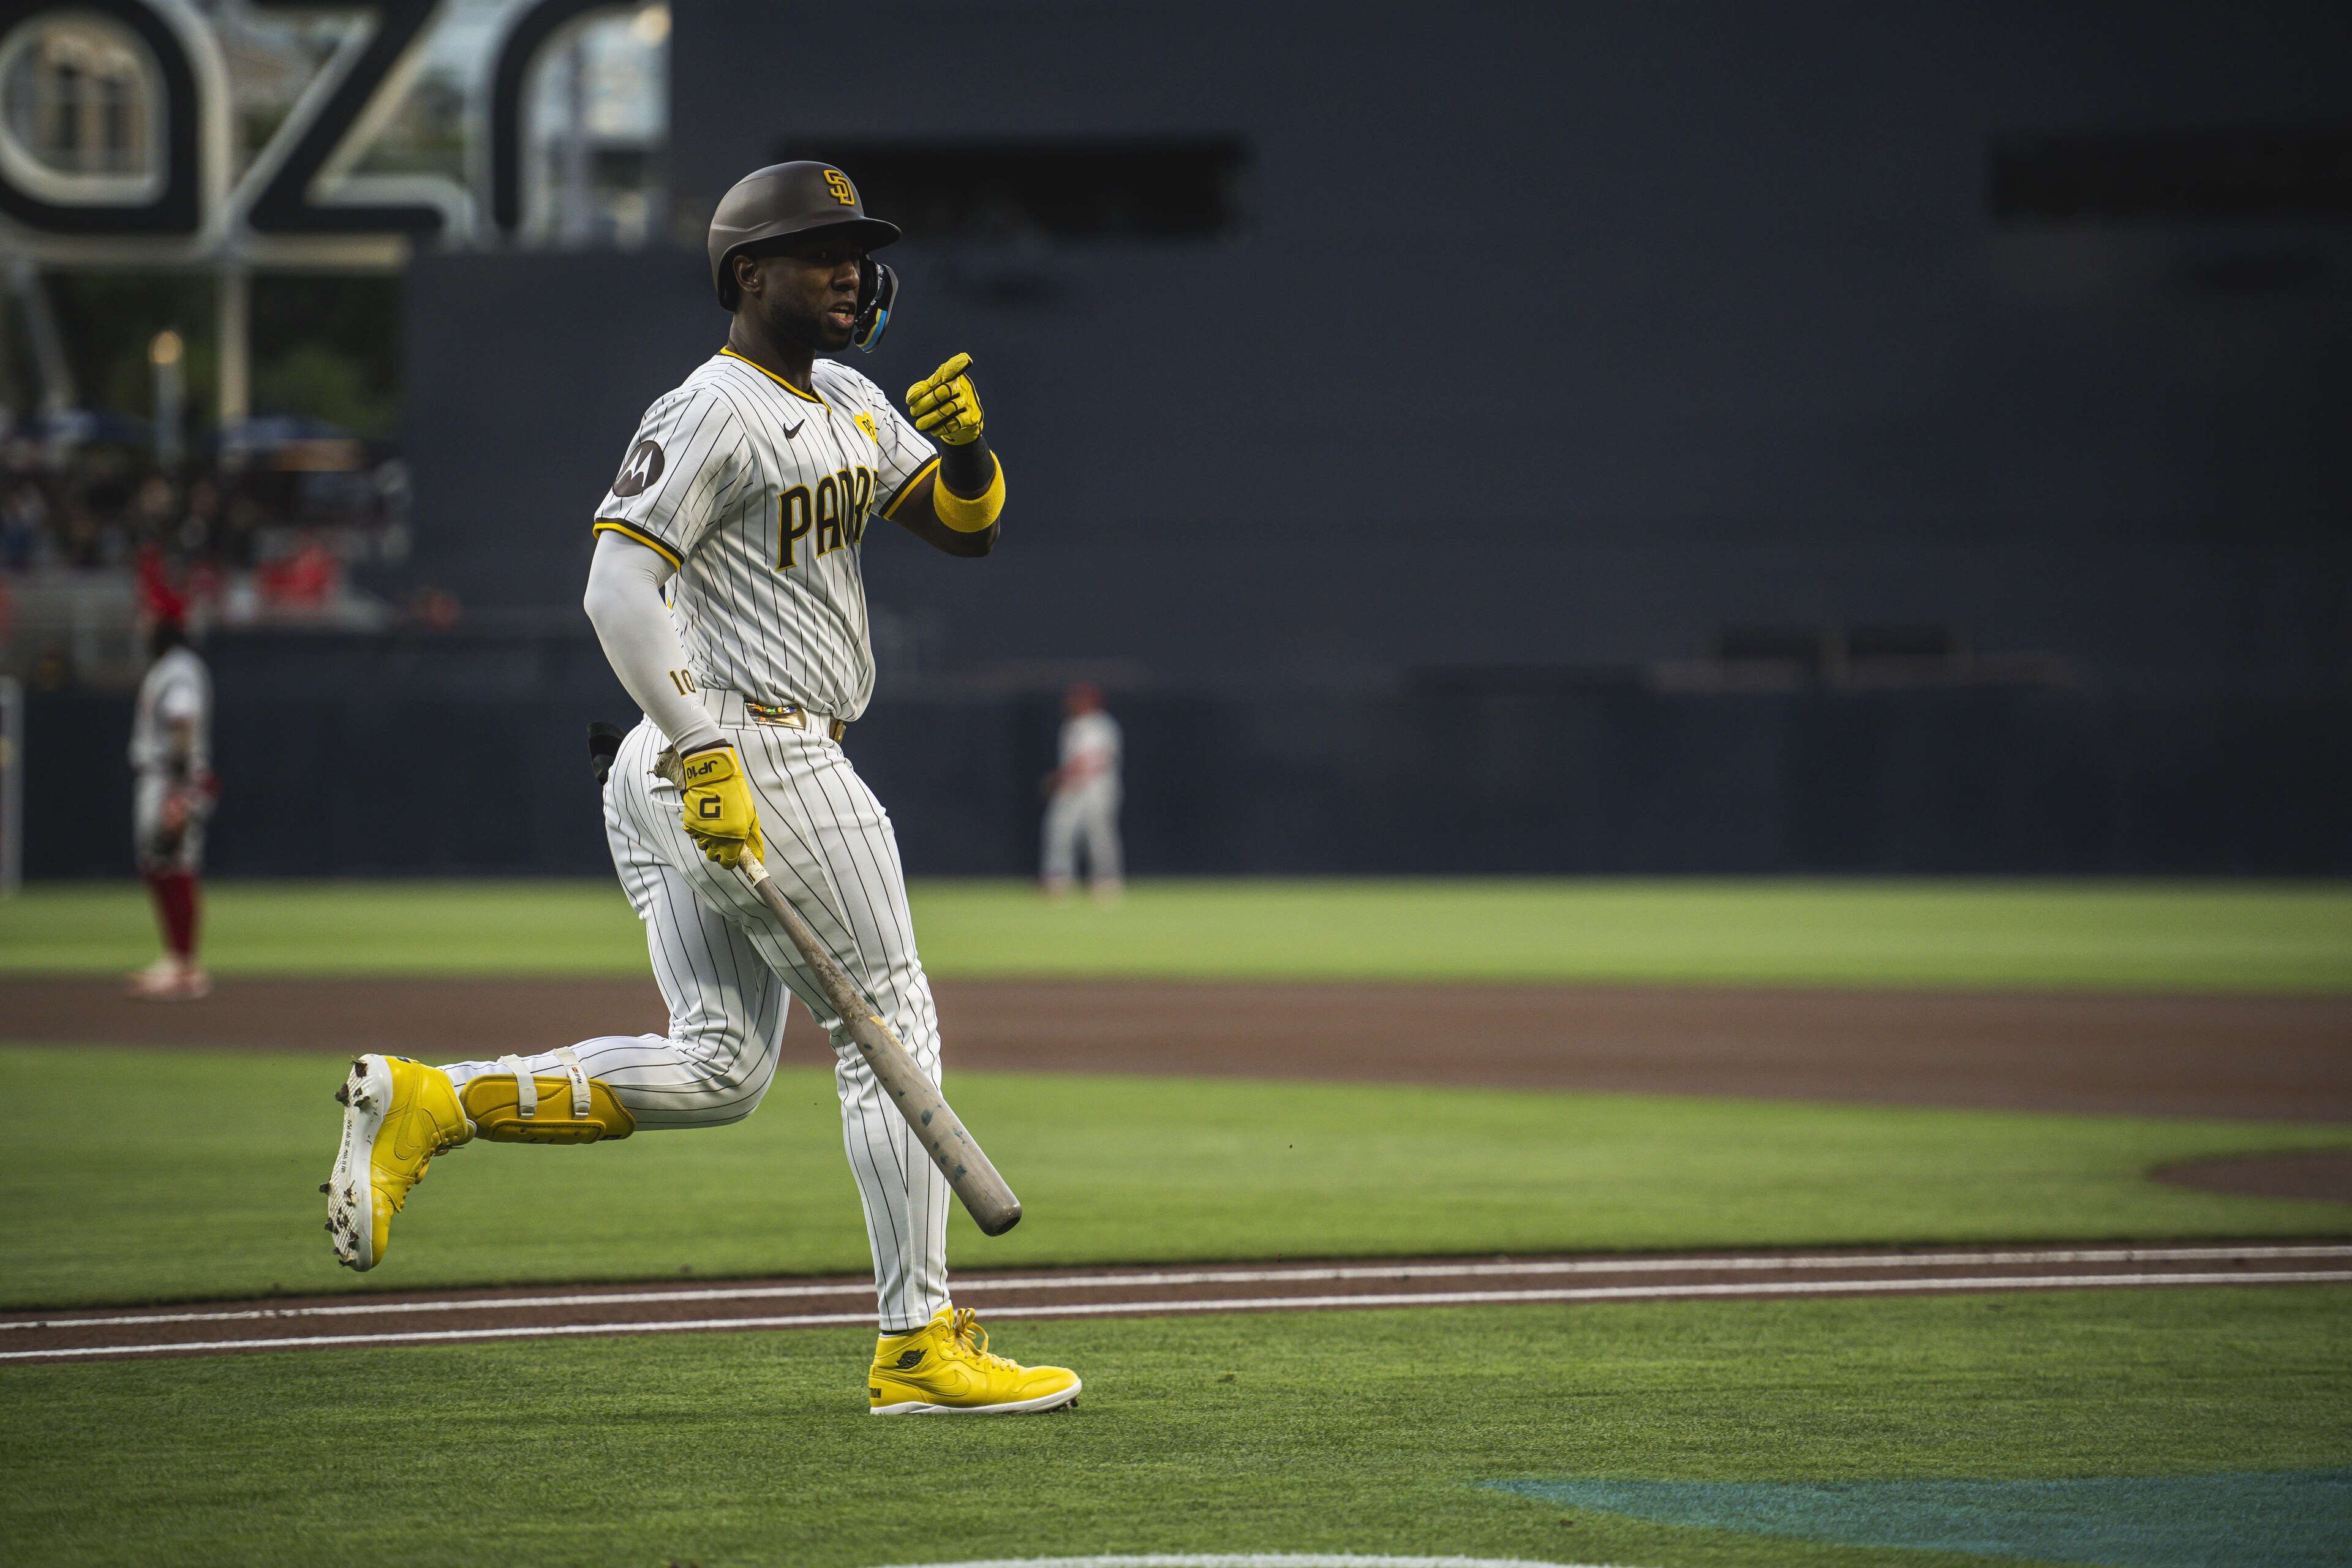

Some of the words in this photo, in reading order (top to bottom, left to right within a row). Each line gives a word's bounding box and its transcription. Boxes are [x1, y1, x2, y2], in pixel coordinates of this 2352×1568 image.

[823, 169, 855, 206] SD
[862, 419, 875, 437] PS
[774, 465, 879, 573] PADR
[669, 668, 696, 696] 10
[686, 760, 718, 780] JP10
